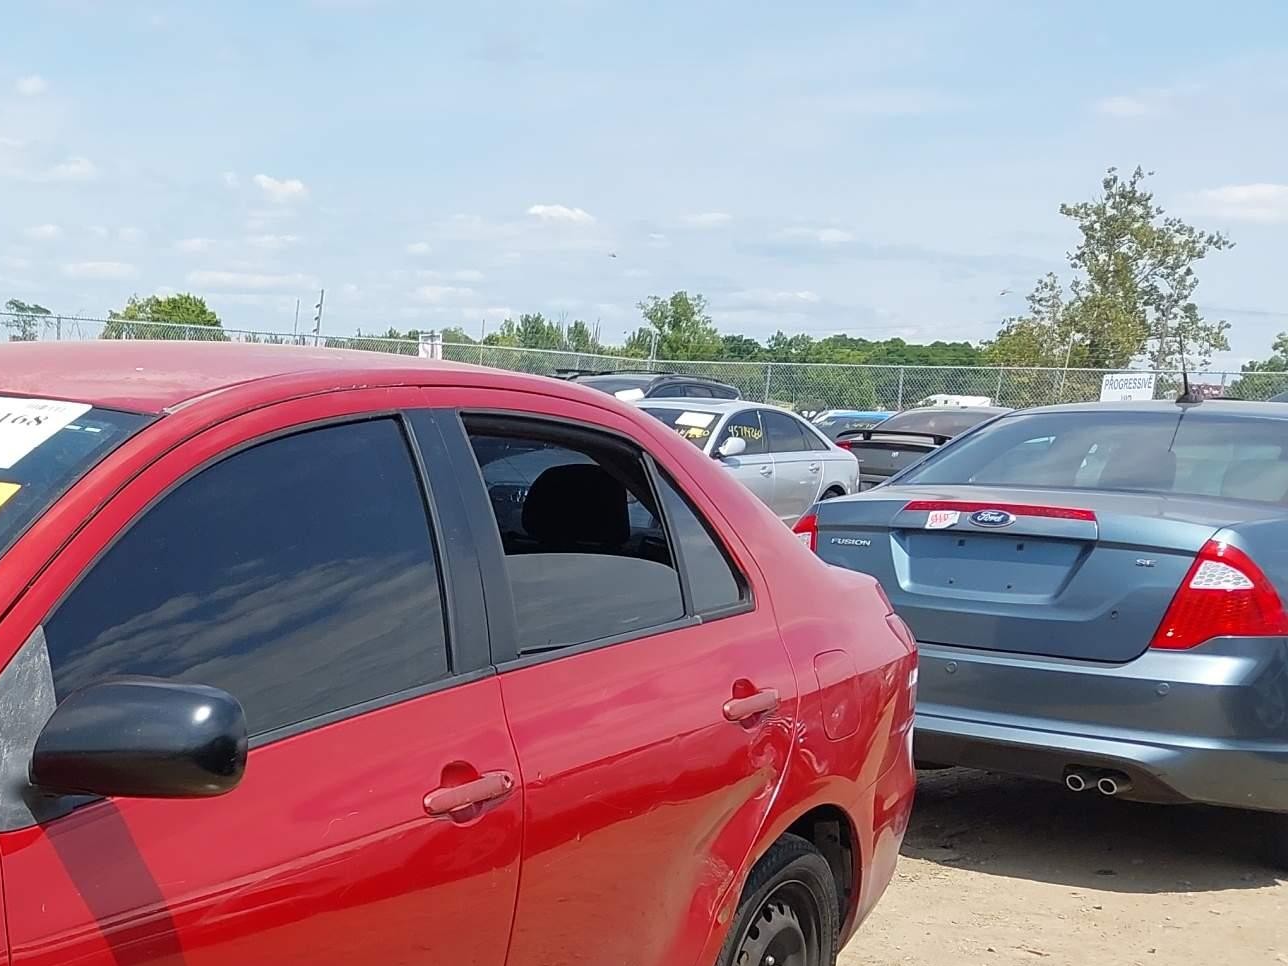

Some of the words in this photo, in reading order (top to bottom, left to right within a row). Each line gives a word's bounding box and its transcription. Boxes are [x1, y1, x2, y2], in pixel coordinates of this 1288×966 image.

[1104, 377, 1153, 390] PROGRESSIVE
[976, 511, 1004, 522] Ford
[831, 538, 871, 546] FUSION
